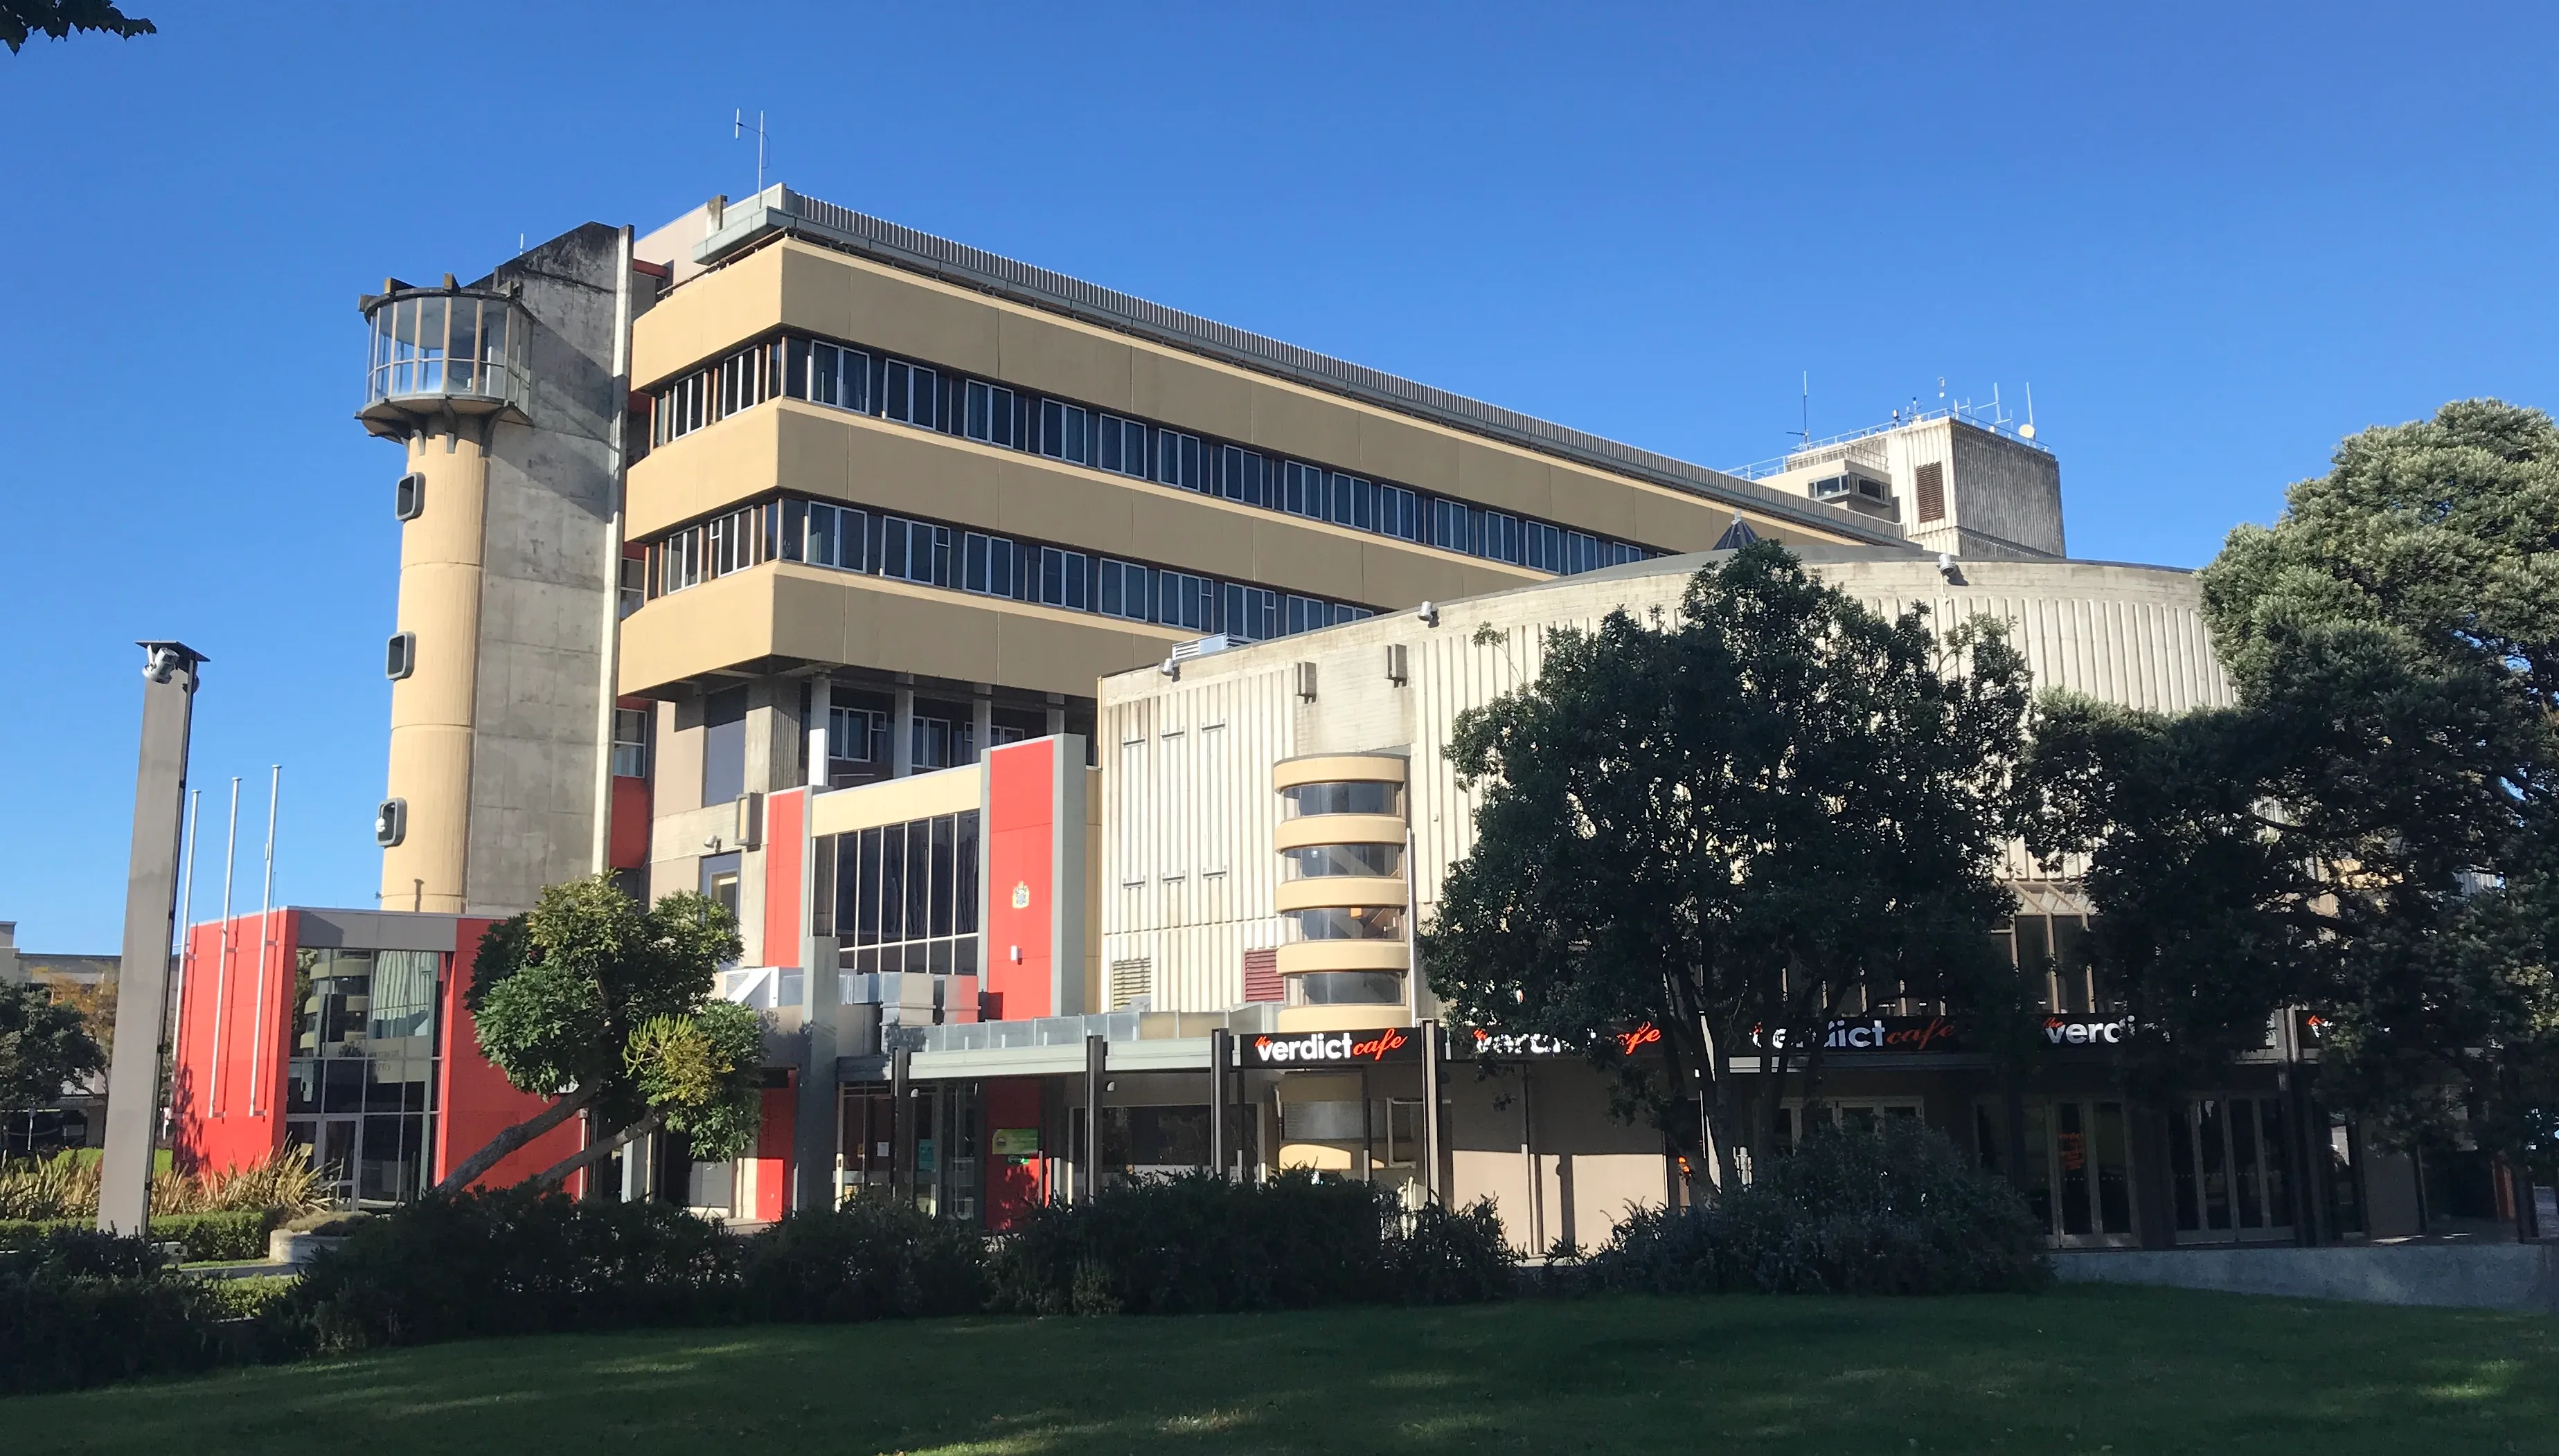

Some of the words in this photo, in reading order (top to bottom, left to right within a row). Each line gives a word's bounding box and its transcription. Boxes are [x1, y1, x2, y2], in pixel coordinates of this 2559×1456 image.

[1257, 1032, 1353, 1061] verdict
[1353, 1028, 1408, 1060] cafe
[1887, 1016, 1956, 1050] cafe
